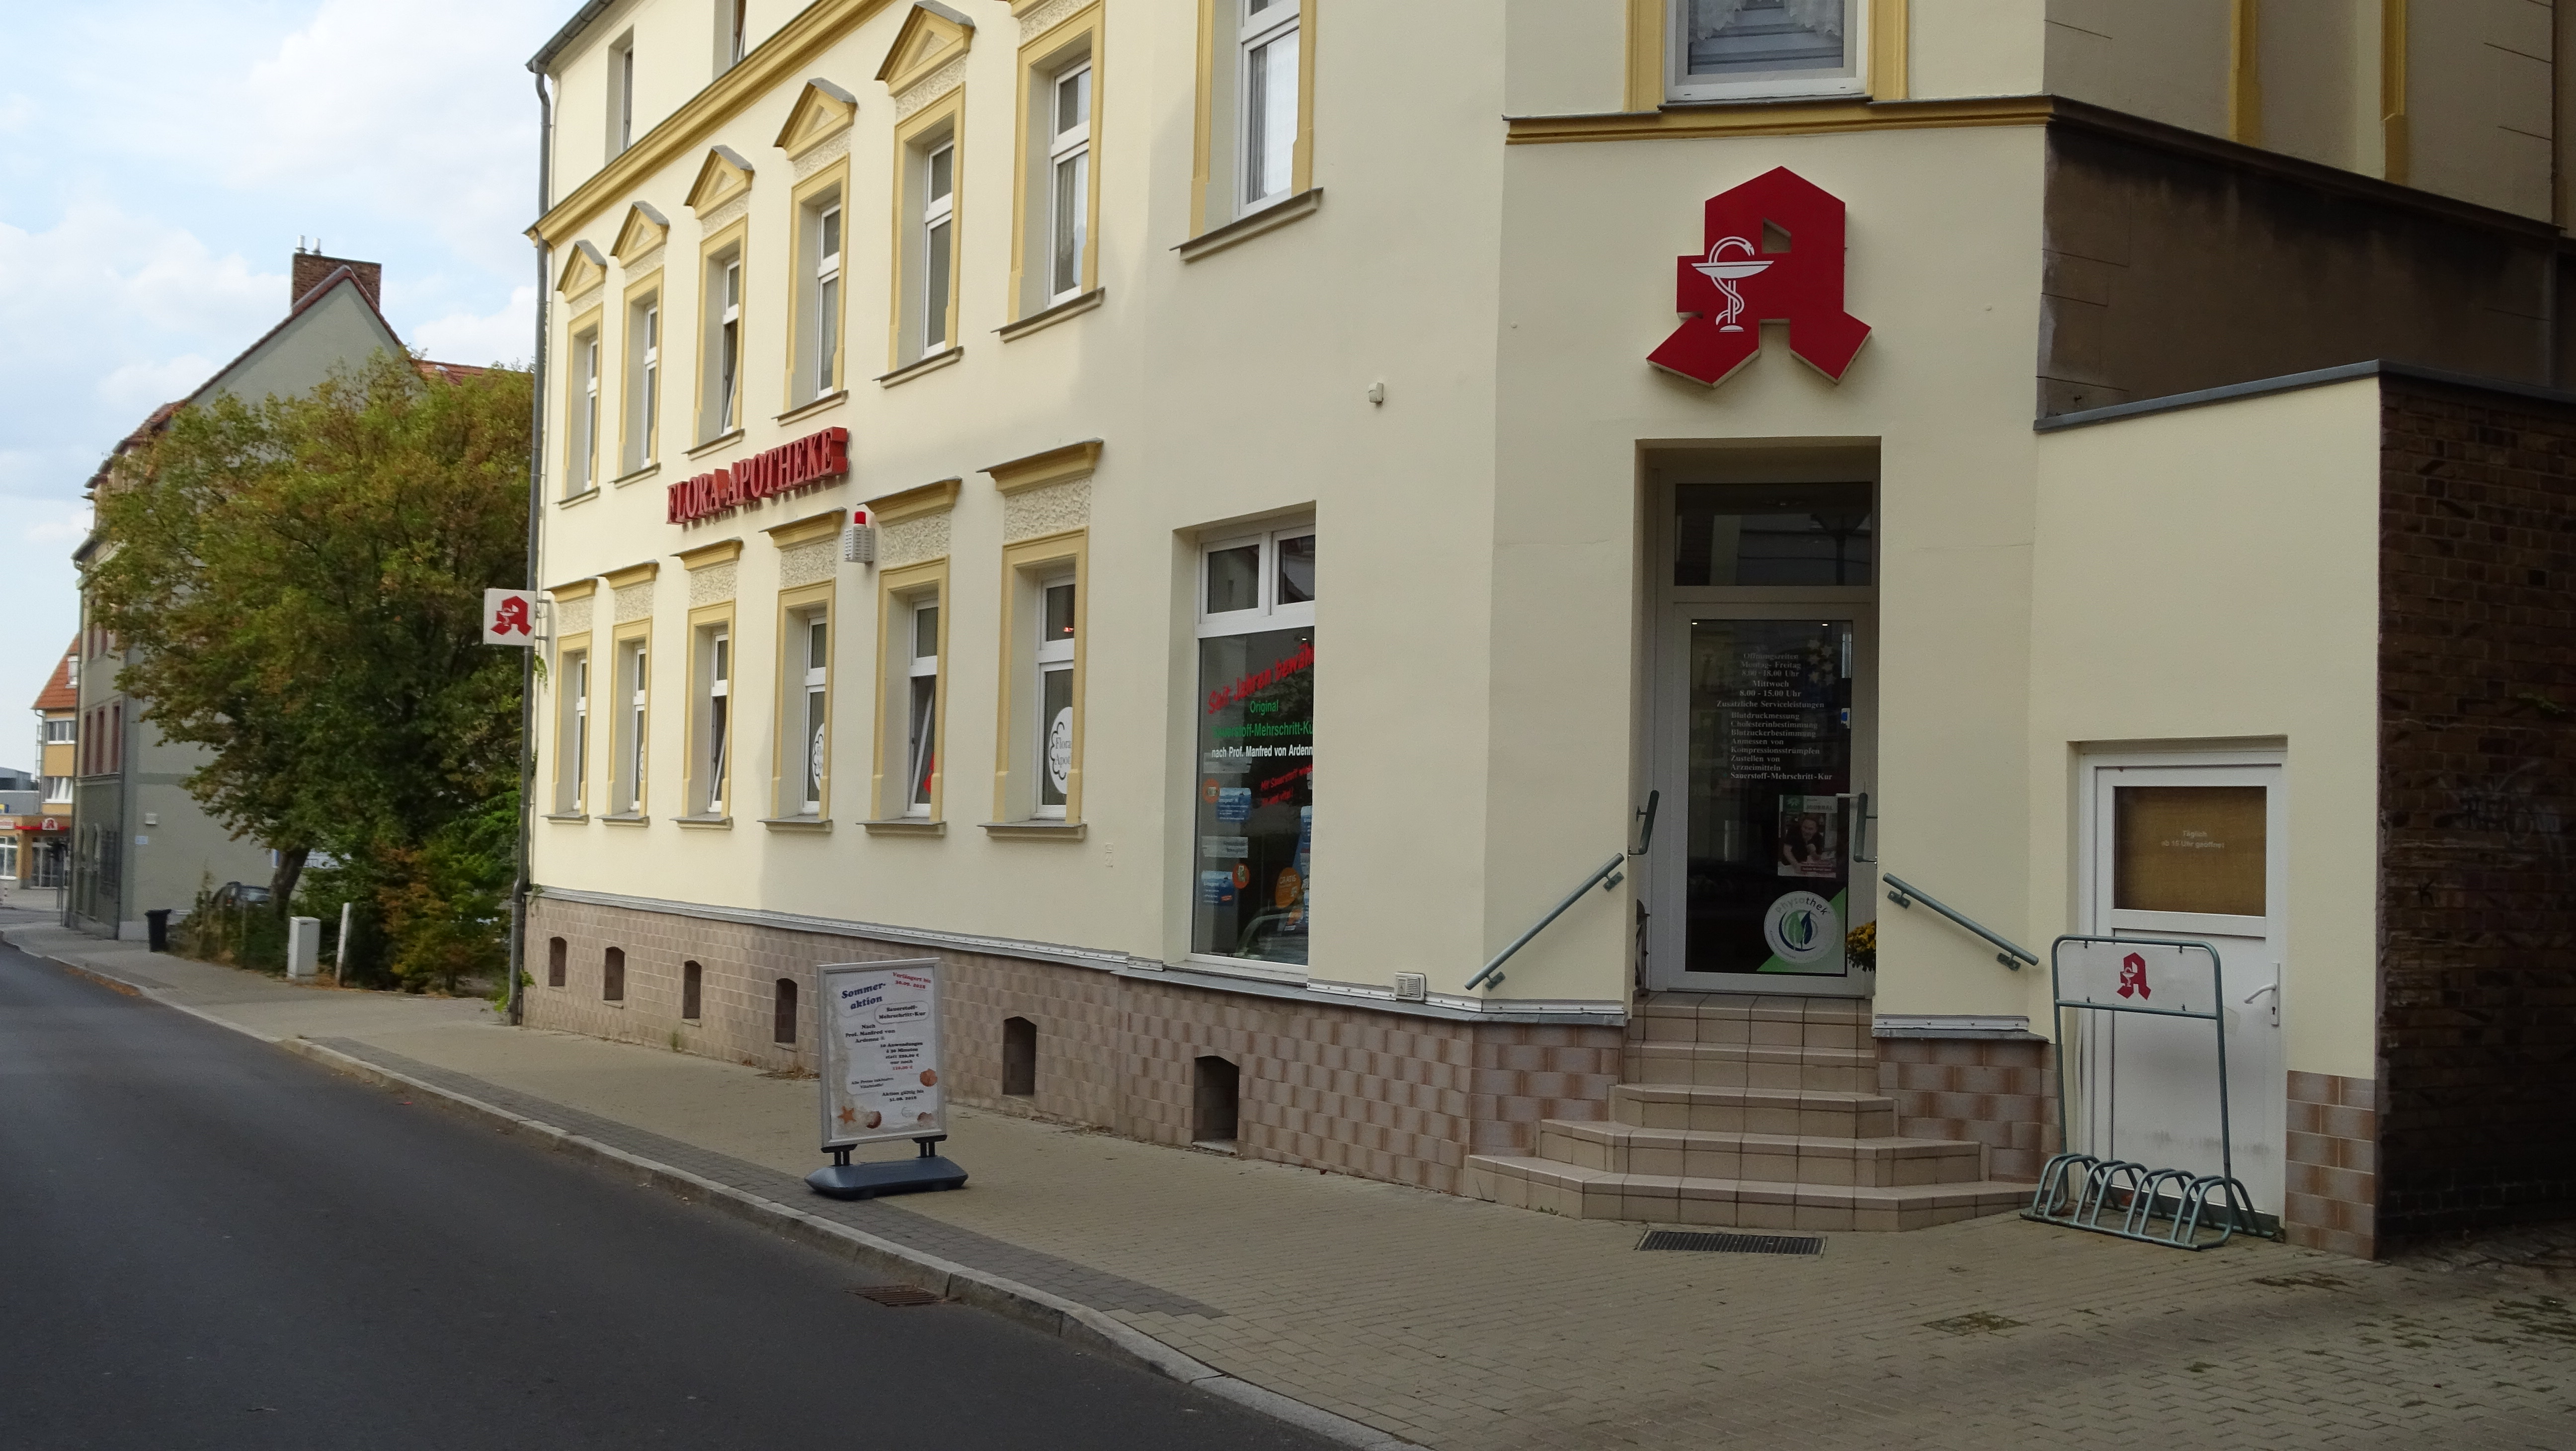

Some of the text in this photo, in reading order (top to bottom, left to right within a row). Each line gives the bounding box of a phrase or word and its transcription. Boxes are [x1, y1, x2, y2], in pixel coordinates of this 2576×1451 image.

[1775, 661, 1801, 670] Freitag
[1250, 699, 1279, 716] Original
[1761, 701, 1825, 709] Serviceleistungen
[1731, 729, 1816, 738] Blutzuckerbestimmung
[1211, 746, 1227, 758] nach
[1229, 746, 1244, 757] Prof.
[1246, 745, 1272, 757] Manfred
[1274, 747, 1286, 756] von
[1731, 746, 1820, 755] Kompressionsstrümpfen
[841, 982, 886, 999] Sommer-
[850, 996, 883, 1010] aktion
